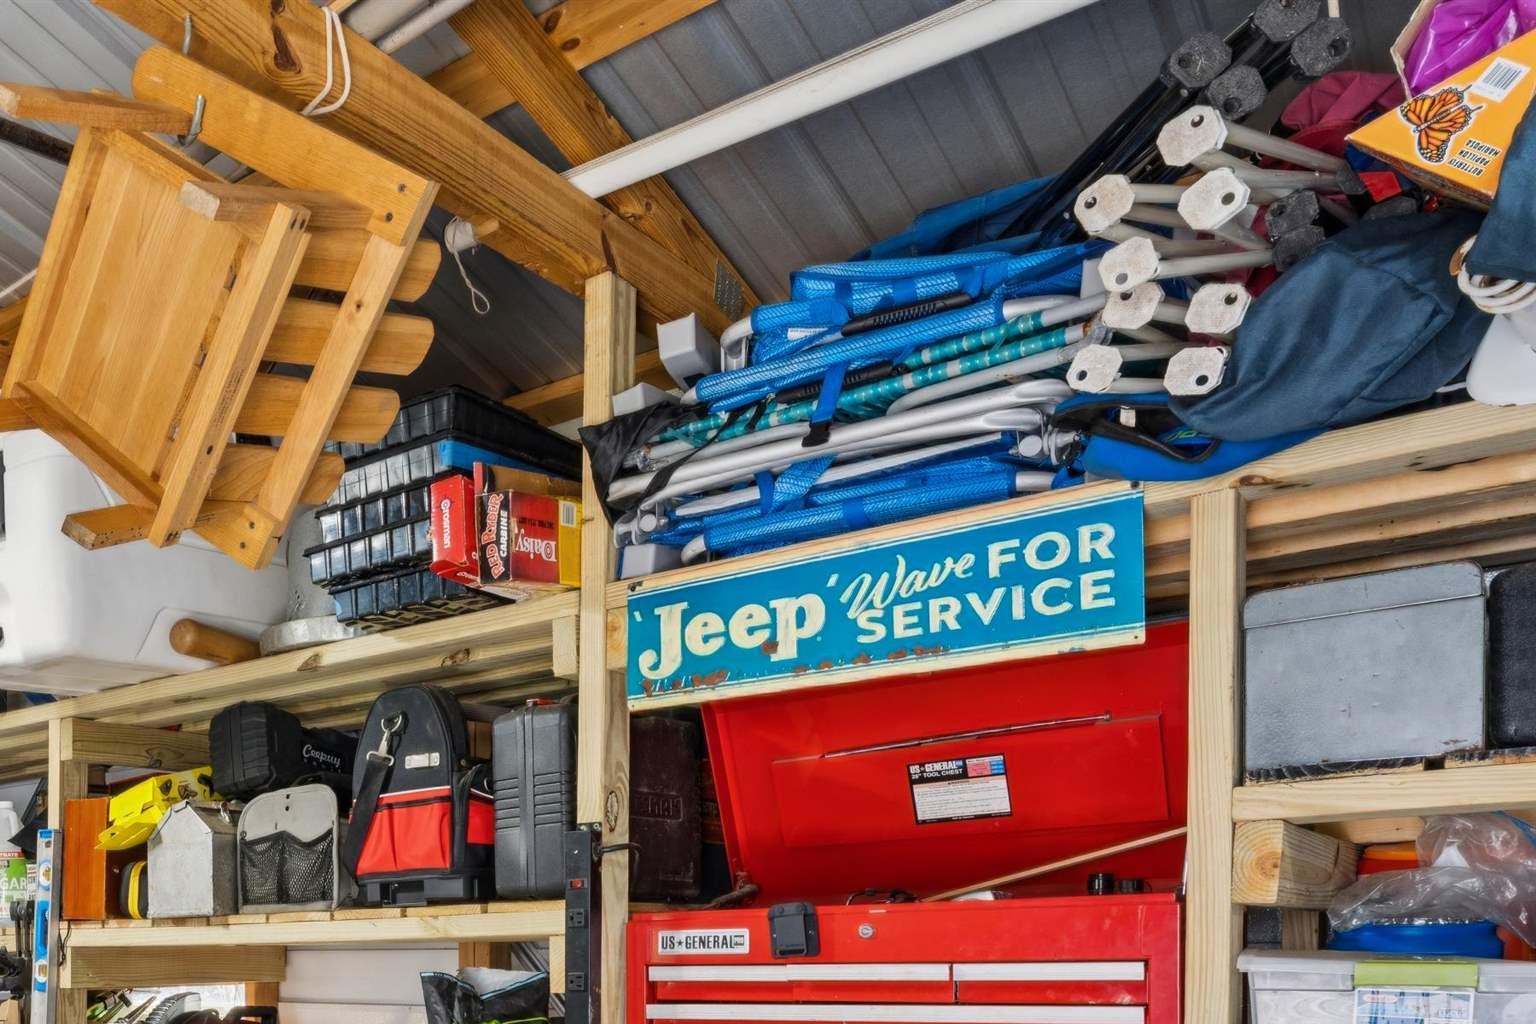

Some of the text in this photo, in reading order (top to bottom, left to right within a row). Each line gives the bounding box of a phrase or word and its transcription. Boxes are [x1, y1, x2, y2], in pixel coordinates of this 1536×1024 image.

[1458, 150, 1490, 166] PAPILLON
[1466, 139, 1500, 157] MARIPOSA
[1449, 159, 1483, 176] BUTTERFLY
[441, 499, 451, 549] Crosman
[481, 493, 506, 579] RED RYDER
[499, 510, 508, 557] CARBINE
[516, 528, 557, 562] Daisy
[839, 552, 975, 620] Wave
[987, 522, 1116, 579] FOR
[856, 569, 1116, 643] SERVICE
[925, 760, 957, 772] GENERAL
[661, 935, 675, 949] US
[685, 935, 734, 949] GENERAL
